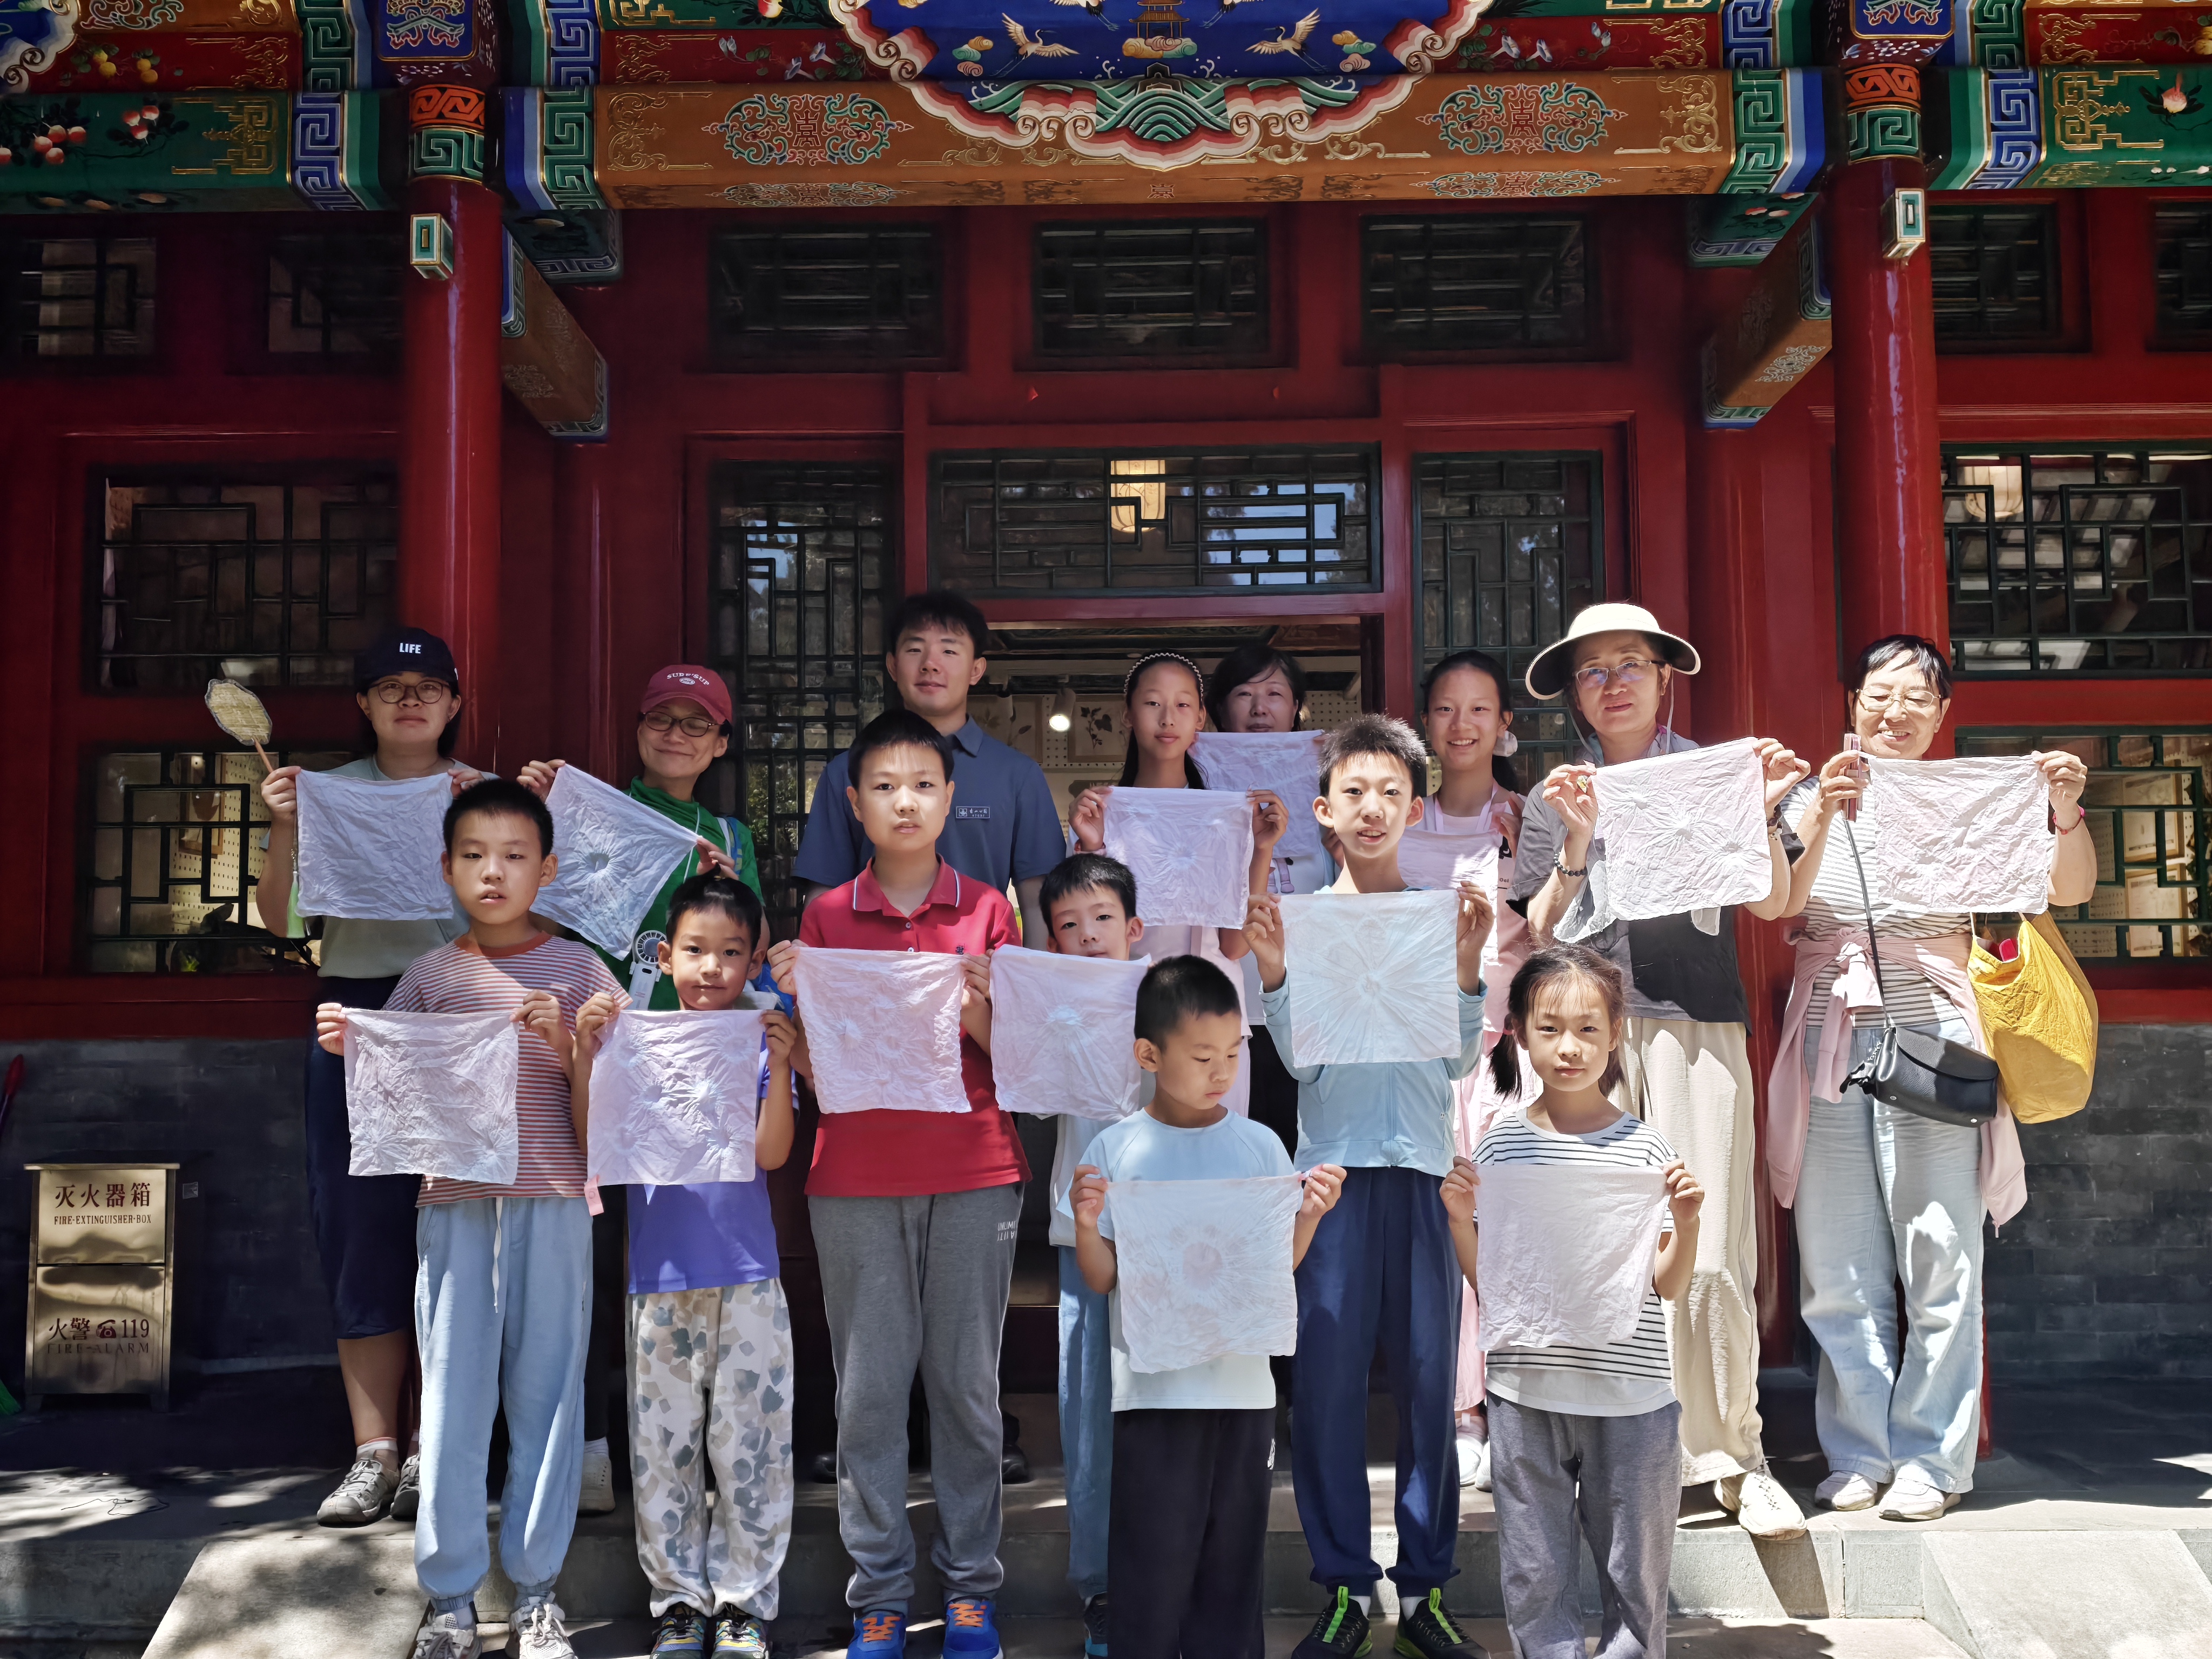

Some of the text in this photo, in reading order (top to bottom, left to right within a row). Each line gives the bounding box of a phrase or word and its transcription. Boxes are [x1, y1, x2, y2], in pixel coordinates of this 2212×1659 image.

[399, 643, 421, 654] LIFE
[55, 1182, 151, 1209] 灭火器箱
[48, 1318, 150, 1341] 火警 119
